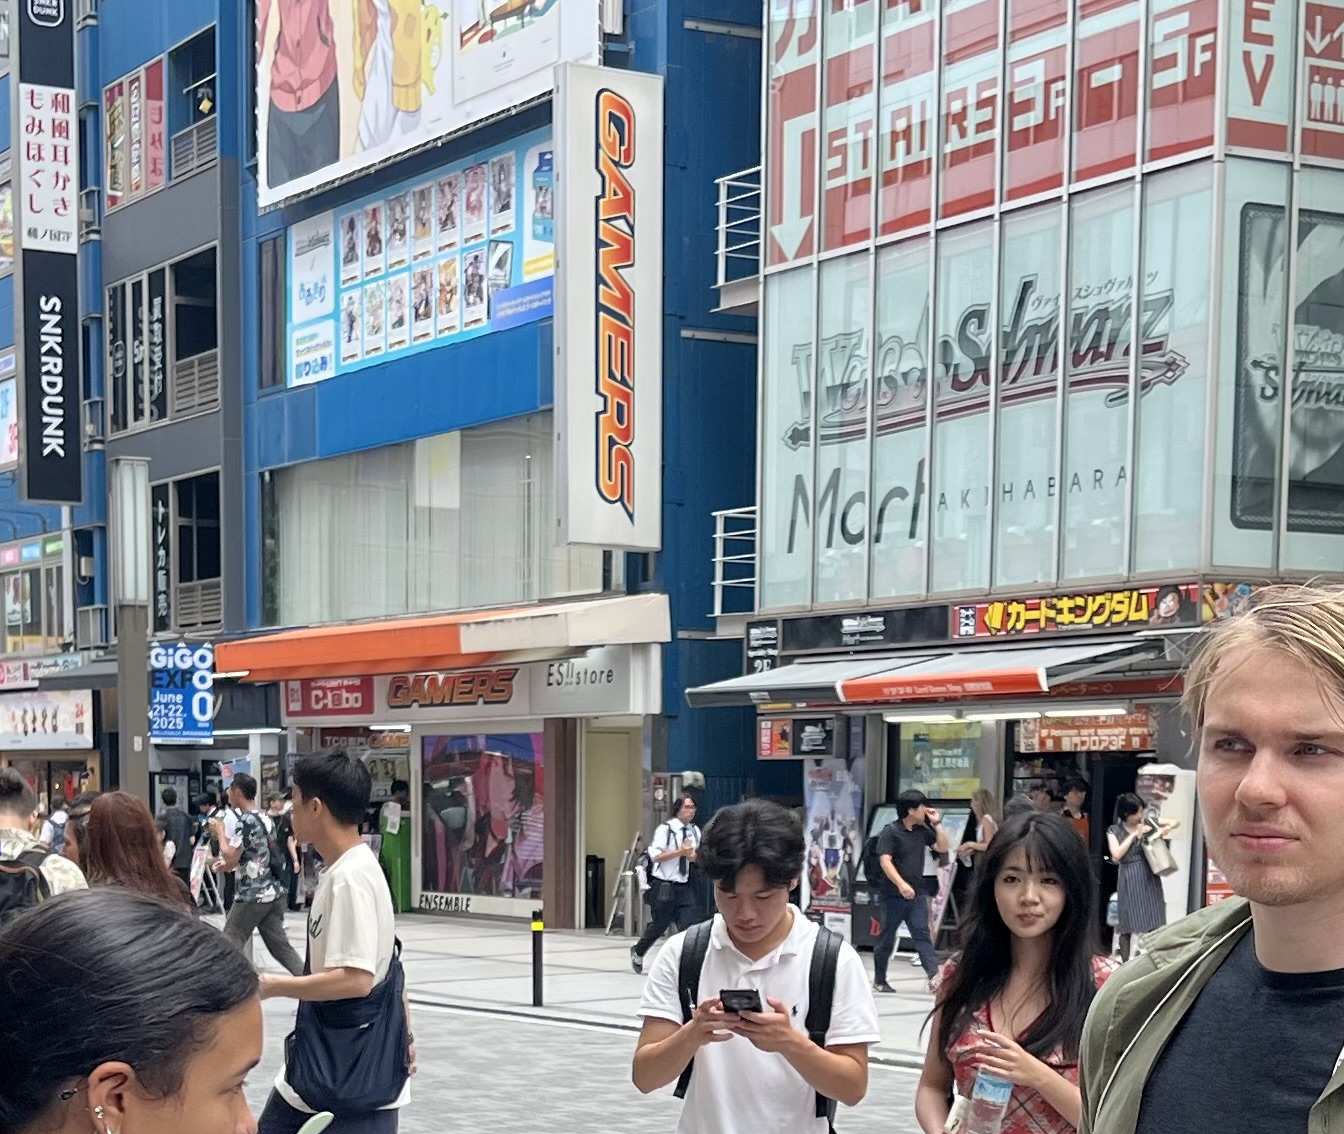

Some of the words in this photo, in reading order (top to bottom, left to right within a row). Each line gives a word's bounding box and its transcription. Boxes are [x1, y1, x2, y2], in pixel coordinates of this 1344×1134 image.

[51, 92, 71, 218] 和風耳かき
[595, 87, 635, 527] GAMERS
[40, 295, 65, 458] SNKRDUNK
[937, 465, 1128, 513] AKIHABARA
[1006, 590, 1150, 632] カードキングダム
[150, 648, 213, 669] GiGO
[154, 690, 183, 703] June
[387, 668, 520, 707] GAMERS
[152, 717, 183, 730] 2025
[419, 893, 472, 913] ENSEMBLE
